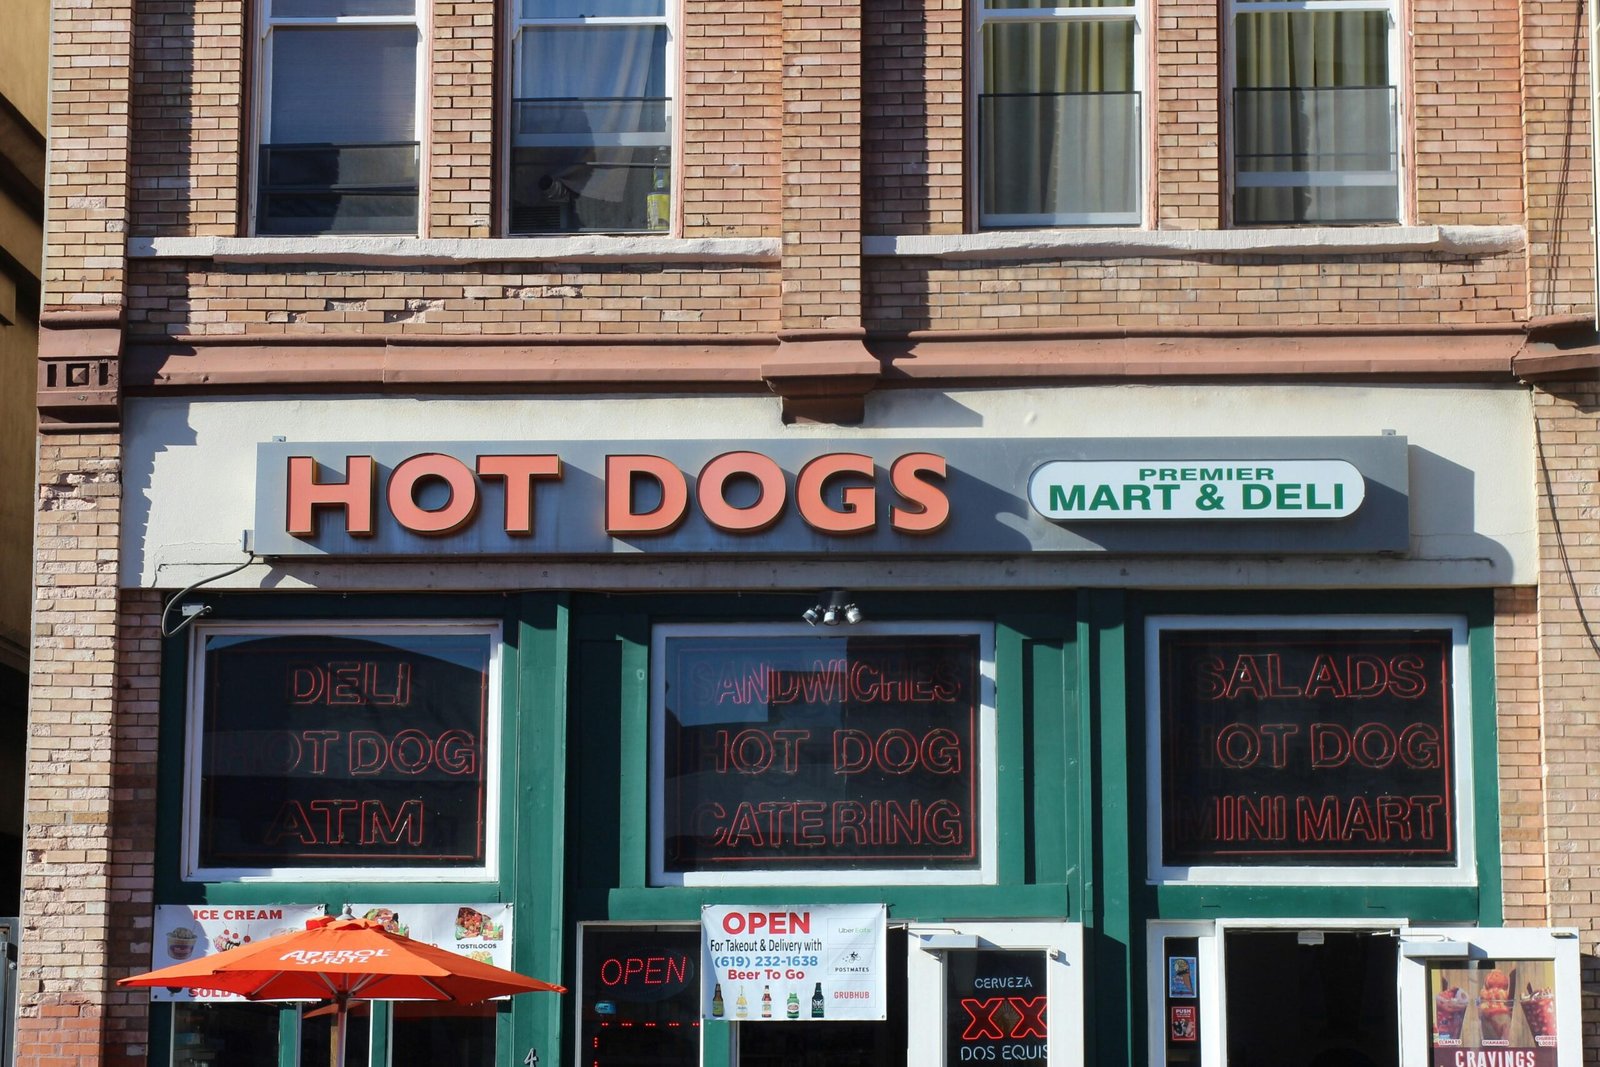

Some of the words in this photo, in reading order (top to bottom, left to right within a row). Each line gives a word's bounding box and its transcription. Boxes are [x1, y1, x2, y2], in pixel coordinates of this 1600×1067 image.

[1138, 467, 1275, 481] PREMIER
[286, 452, 561, 536] HOT
[605, 451, 950, 536] DOGS
[1048, 484, 1181, 511] MART
[1195, 483, 1225, 511] &
[1242, 483, 1344, 510] DELI
[288, 662, 412, 705] DELI
[1193, 652, 1428, 700] SALADS
[349, 728, 476, 775] DOG
[833, 728, 962, 775] DOG
[1310, 722, 1441, 769] DOG
[264, 799, 424, 845] ATM
[690, 799, 963, 848] CATERING
[1296, 795, 1442, 842] MART
[193, 909, 219, 921] ICE
[223, 909, 283, 921] CREAM
[722, 911, 811, 935] OPEN
[279, 949, 389, 961] APEROL
[710, 939, 724, 952] For
[726, 939, 757, 952] Takeout
[760, 939, 767, 952] &
[769, 939, 802, 954] Delivery
[804, 938, 823, 952] with
[601, 956, 687, 986] OPEN
[714, 956, 751, 968] (619)
[754, 955, 819, 967] 232-1638
[728, 969, 760, 980] Beer
[764, 969, 781, 980] To
[785, 969, 805, 980] Go
[834, 991, 870, 999] GRUBHUB
[974, 976, 1033, 989] CERVEZA
[961, 996, 1048, 1040] XX
[960, 1045, 996, 1061] DOS
[1455, 1051, 1535, 1067] CRAVINGS
